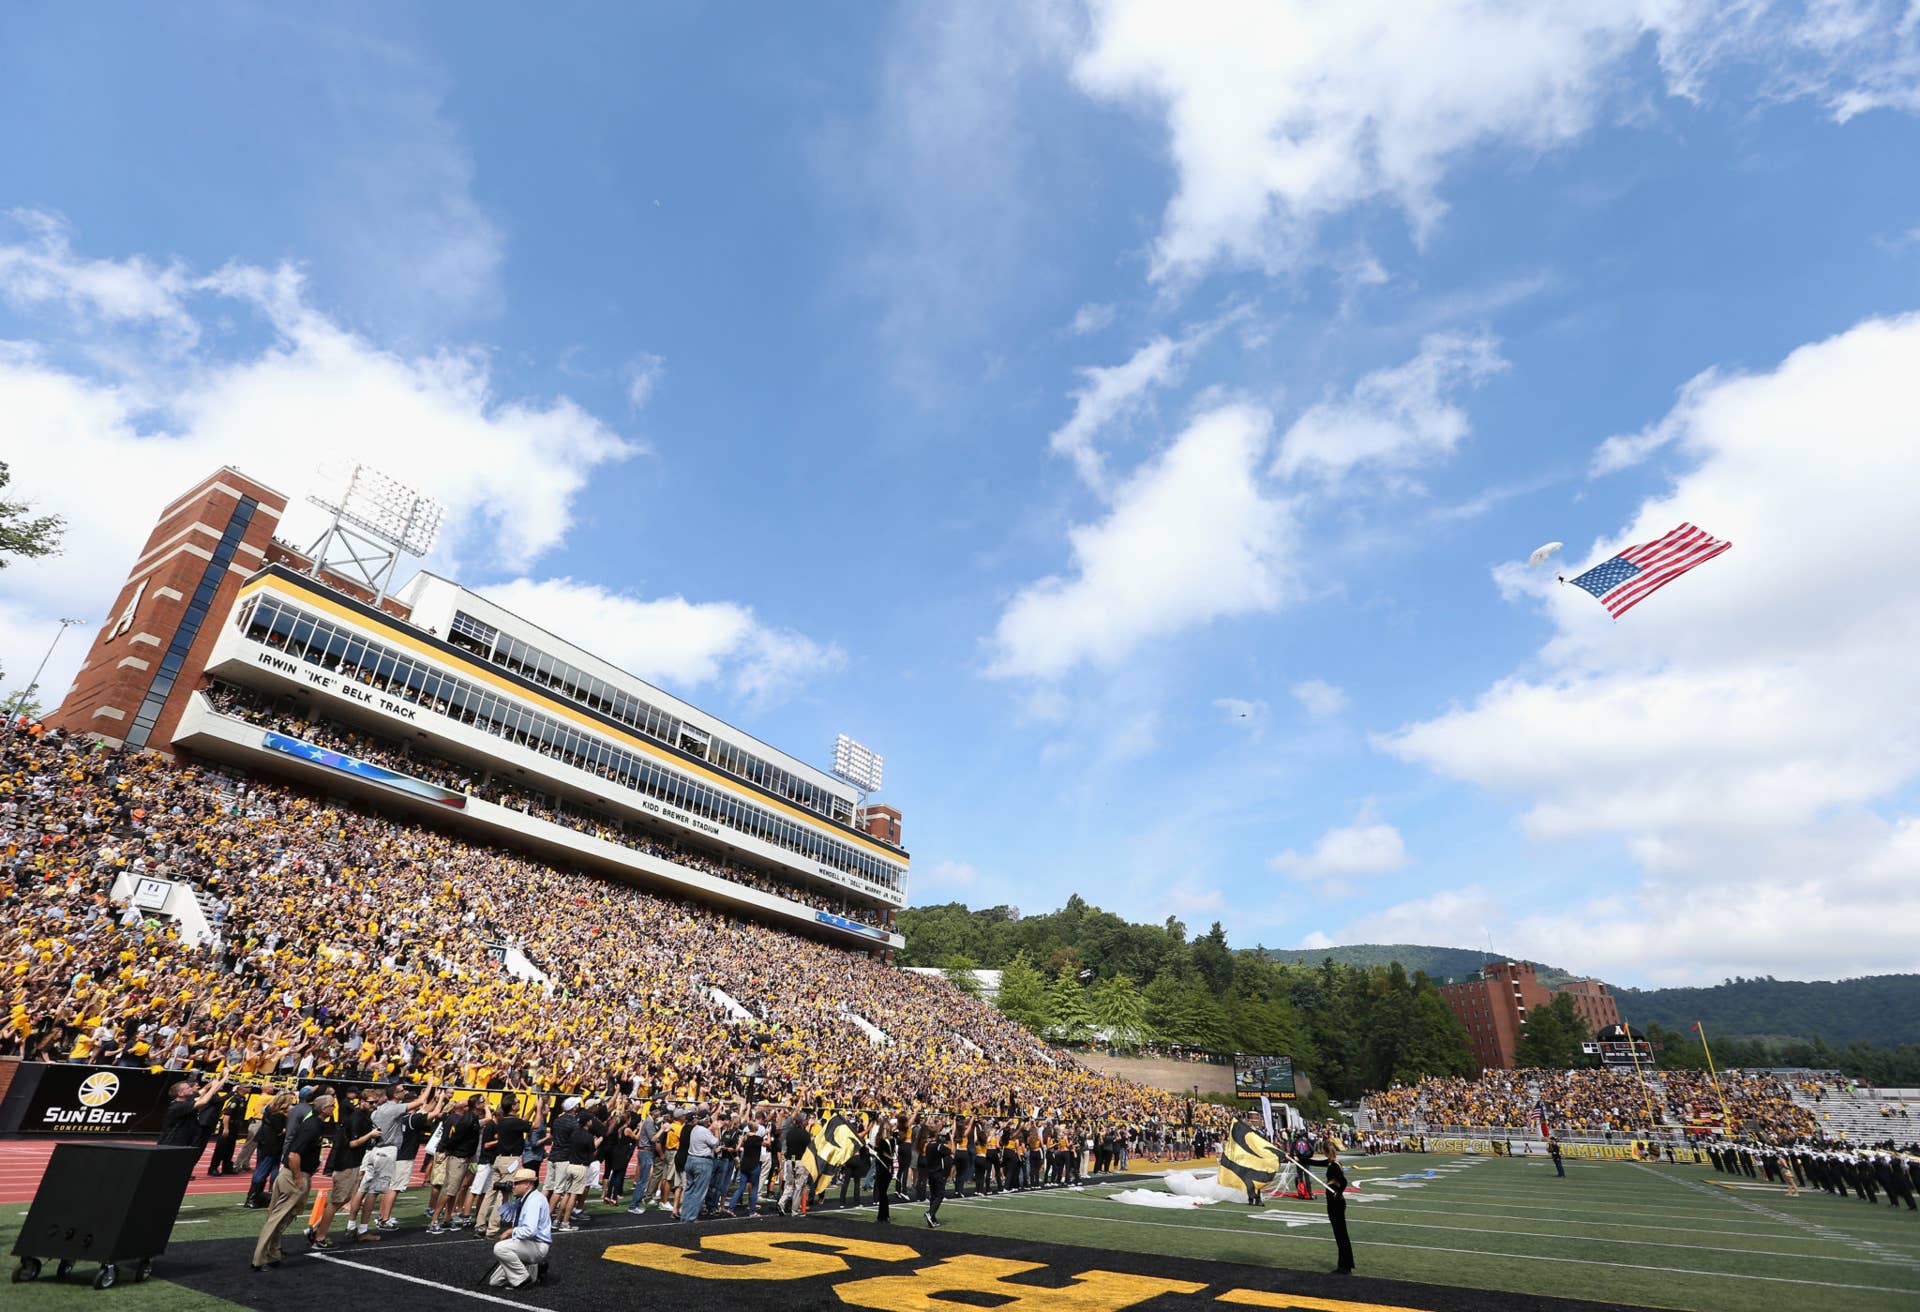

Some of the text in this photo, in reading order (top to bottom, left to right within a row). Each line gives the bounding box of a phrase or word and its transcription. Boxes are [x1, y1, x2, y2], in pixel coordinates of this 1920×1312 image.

[258, 653, 417, 720] IRWIN "IKE" BELK TRACK
[642, 801, 719, 835] KIDD BREWER STADIUM
[819, 868, 840, 880] WENDELL
[53, 1124, 112, 1132] CONFERENCE
[1429, 1140, 1471, 1152] YOSEF
[1557, 1143, 1632, 1158] HAMPIONS
